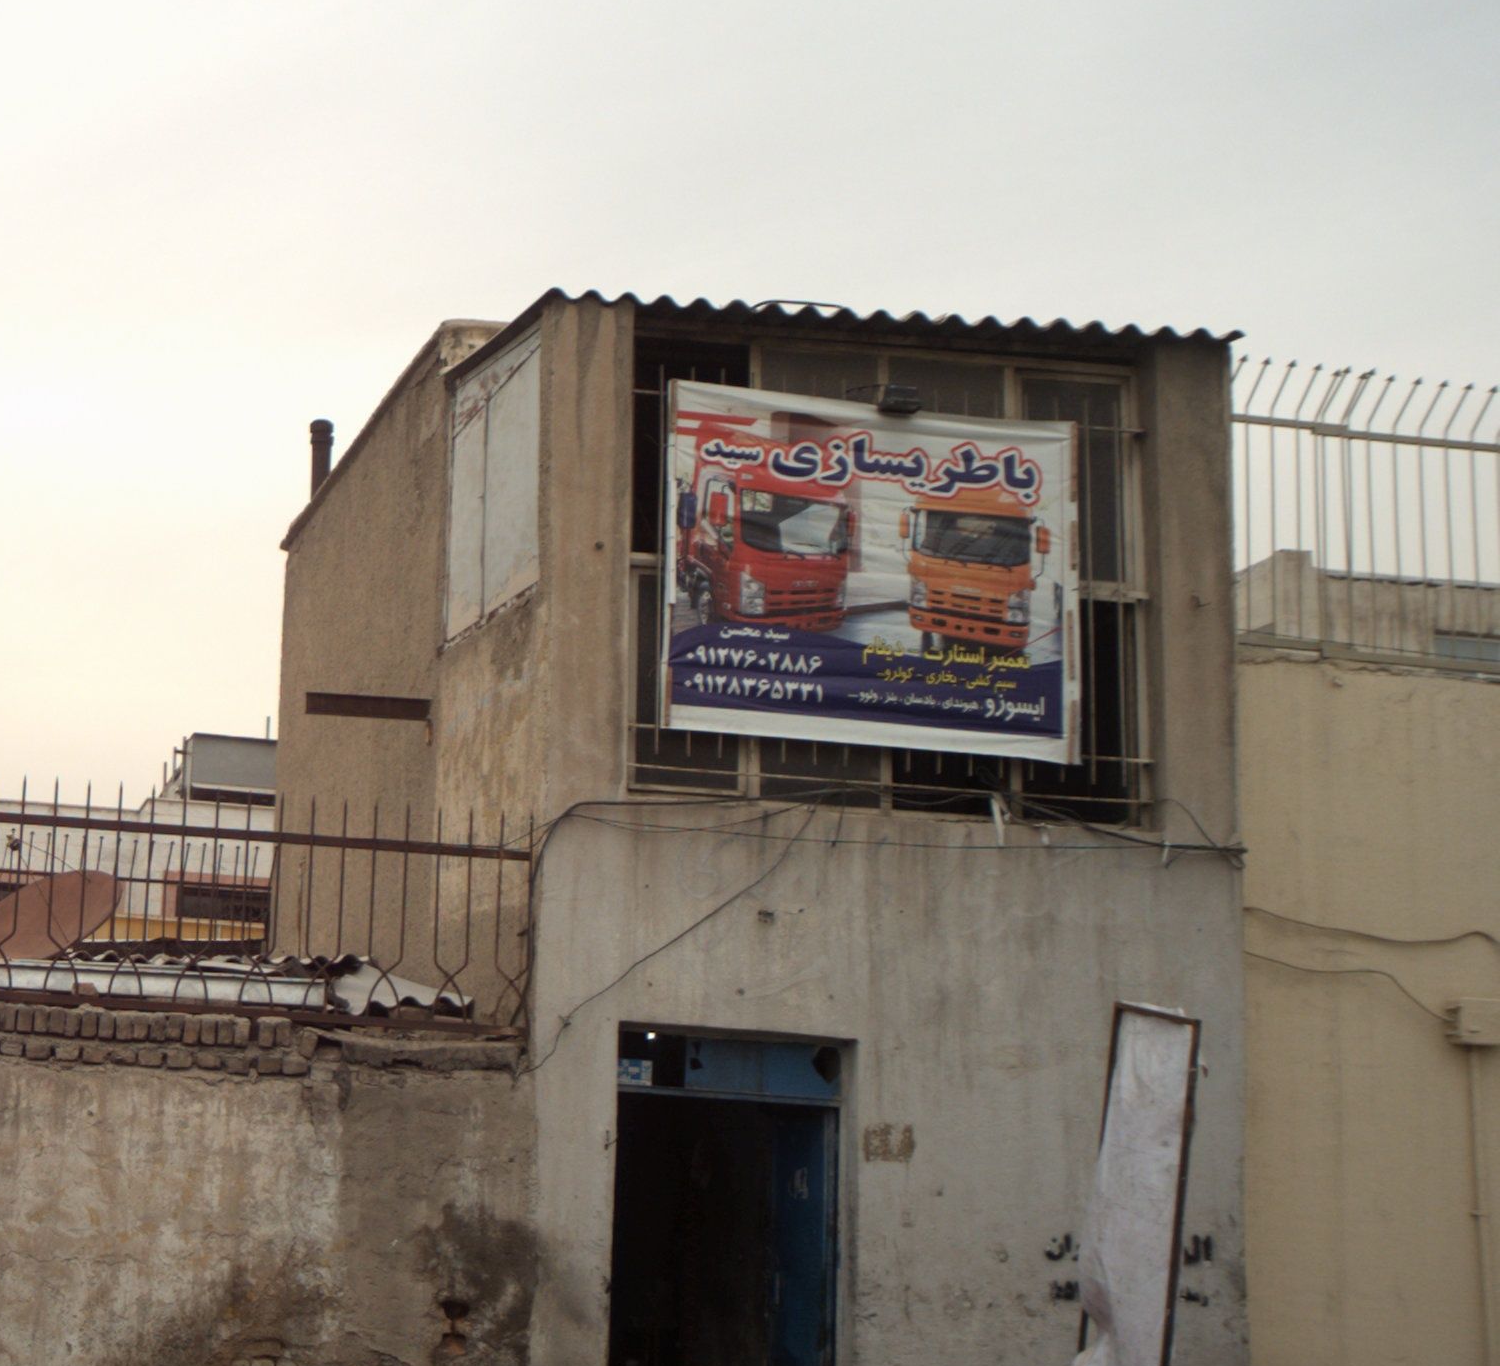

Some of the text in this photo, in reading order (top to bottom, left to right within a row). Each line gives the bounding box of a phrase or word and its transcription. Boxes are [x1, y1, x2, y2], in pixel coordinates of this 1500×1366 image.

[702, 438, 762, 465] سید
[719, 626, 791, 643] سید محسن
[685, 645, 823, 675] ۰۹۱۲۷۶۰۲۸۸۶
[923, 643, 985, 667] استارت
[987, 652, 1031, 672] تعمیر
[684, 672, 824, 703] ۰۹۱۲۸۳۶۵۳۳۱
[925, 670, 957, 687] بخاری
[984, 694, 1045, 722] ایسوزو
